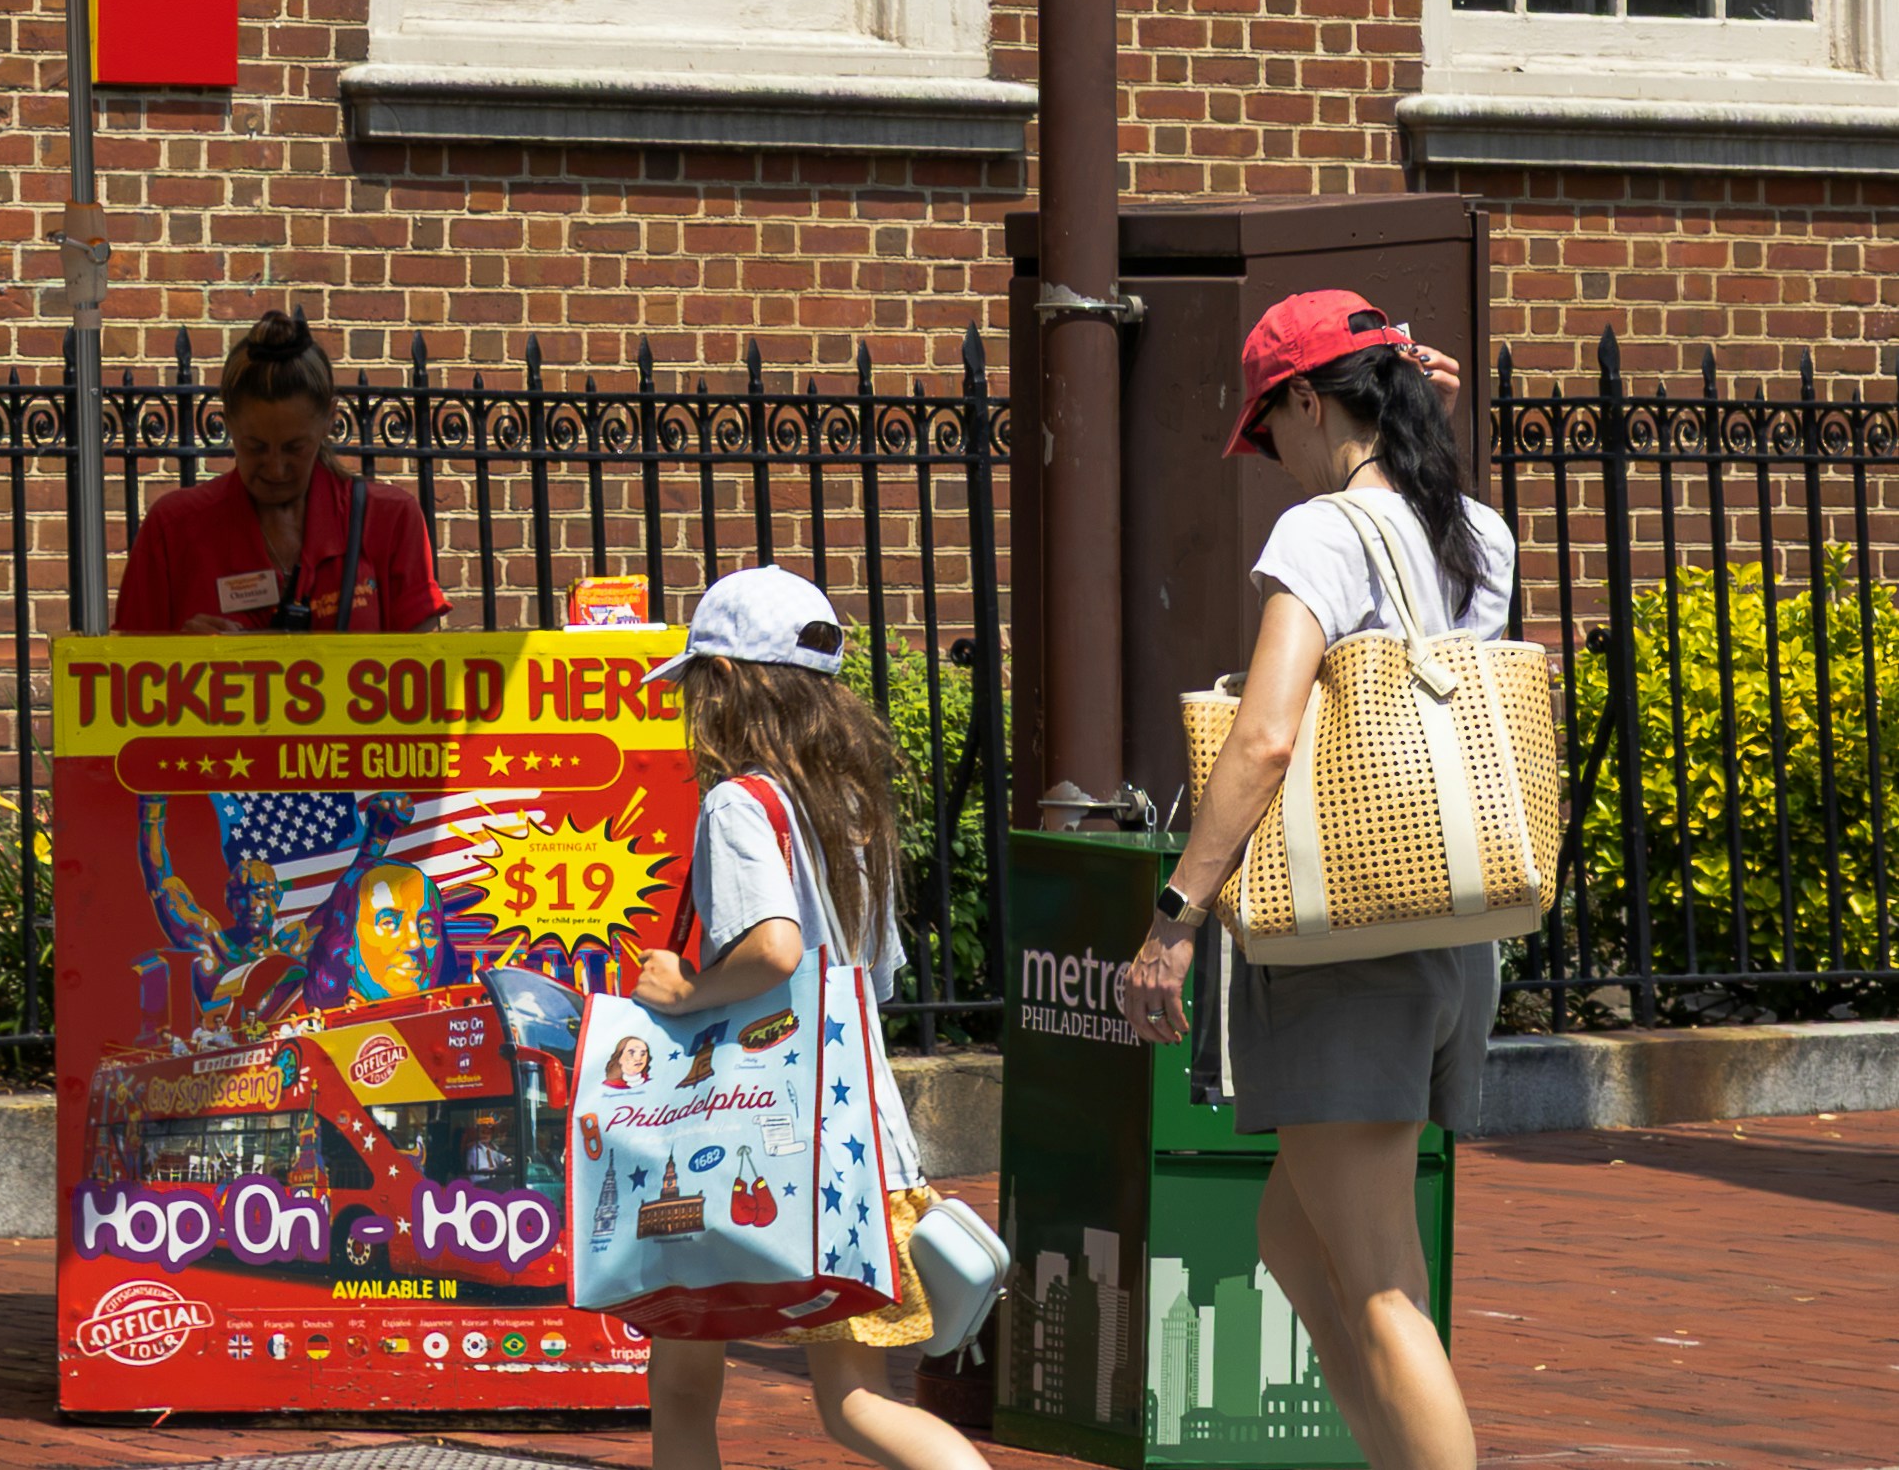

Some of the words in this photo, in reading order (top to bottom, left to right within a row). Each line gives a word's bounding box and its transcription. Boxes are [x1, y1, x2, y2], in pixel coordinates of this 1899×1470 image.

[68, 659, 325, 727] TICKETS
[347, 657, 506, 726] SOLD
[527, 657, 682, 722] HERE
[279, 743, 349, 780] LIVE
[361, 741, 461, 779] GUIDE
[529, 842, 583, 853] STARTING
[584, 842, 599, 852] AT
[503, 856, 615, 918] $19
[551, 916, 570, 924] child
[449, 1020, 469, 1032] Hop
[470, 1017, 484, 1031] On
[1021, 1004, 1141, 1047] PHILADELPHIA
[448, 1036, 468, 1048] Hop
[469, 1032, 485, 1047] Off
[354, 1047, 406, 1079] OFFICIAL
[370, 1067, 394, 1083] TOUR
[604, 1084, 778, 1133] Philadelphia
[692, 1148, 723, 1171] 1682
[82, 1188, 212, 1263] Hop
[233, 1183, 320, 1255] On
[421, 1188, 552, 1263] Hop
[332, 1279, 435, 1301] AVAILABLE
[439, 1278, 458, 1300] IN
[90, 1305, 206, 1347] OFFICIAL
[226, 1320, 254, 1330] English
[302, 1319, 335, 1329] Deutsch
[461, 1319, 490, 1327] Korean
[542, 1318, 564, 1327] Hindi
[129, 1334, 179, 1359] TOUR
